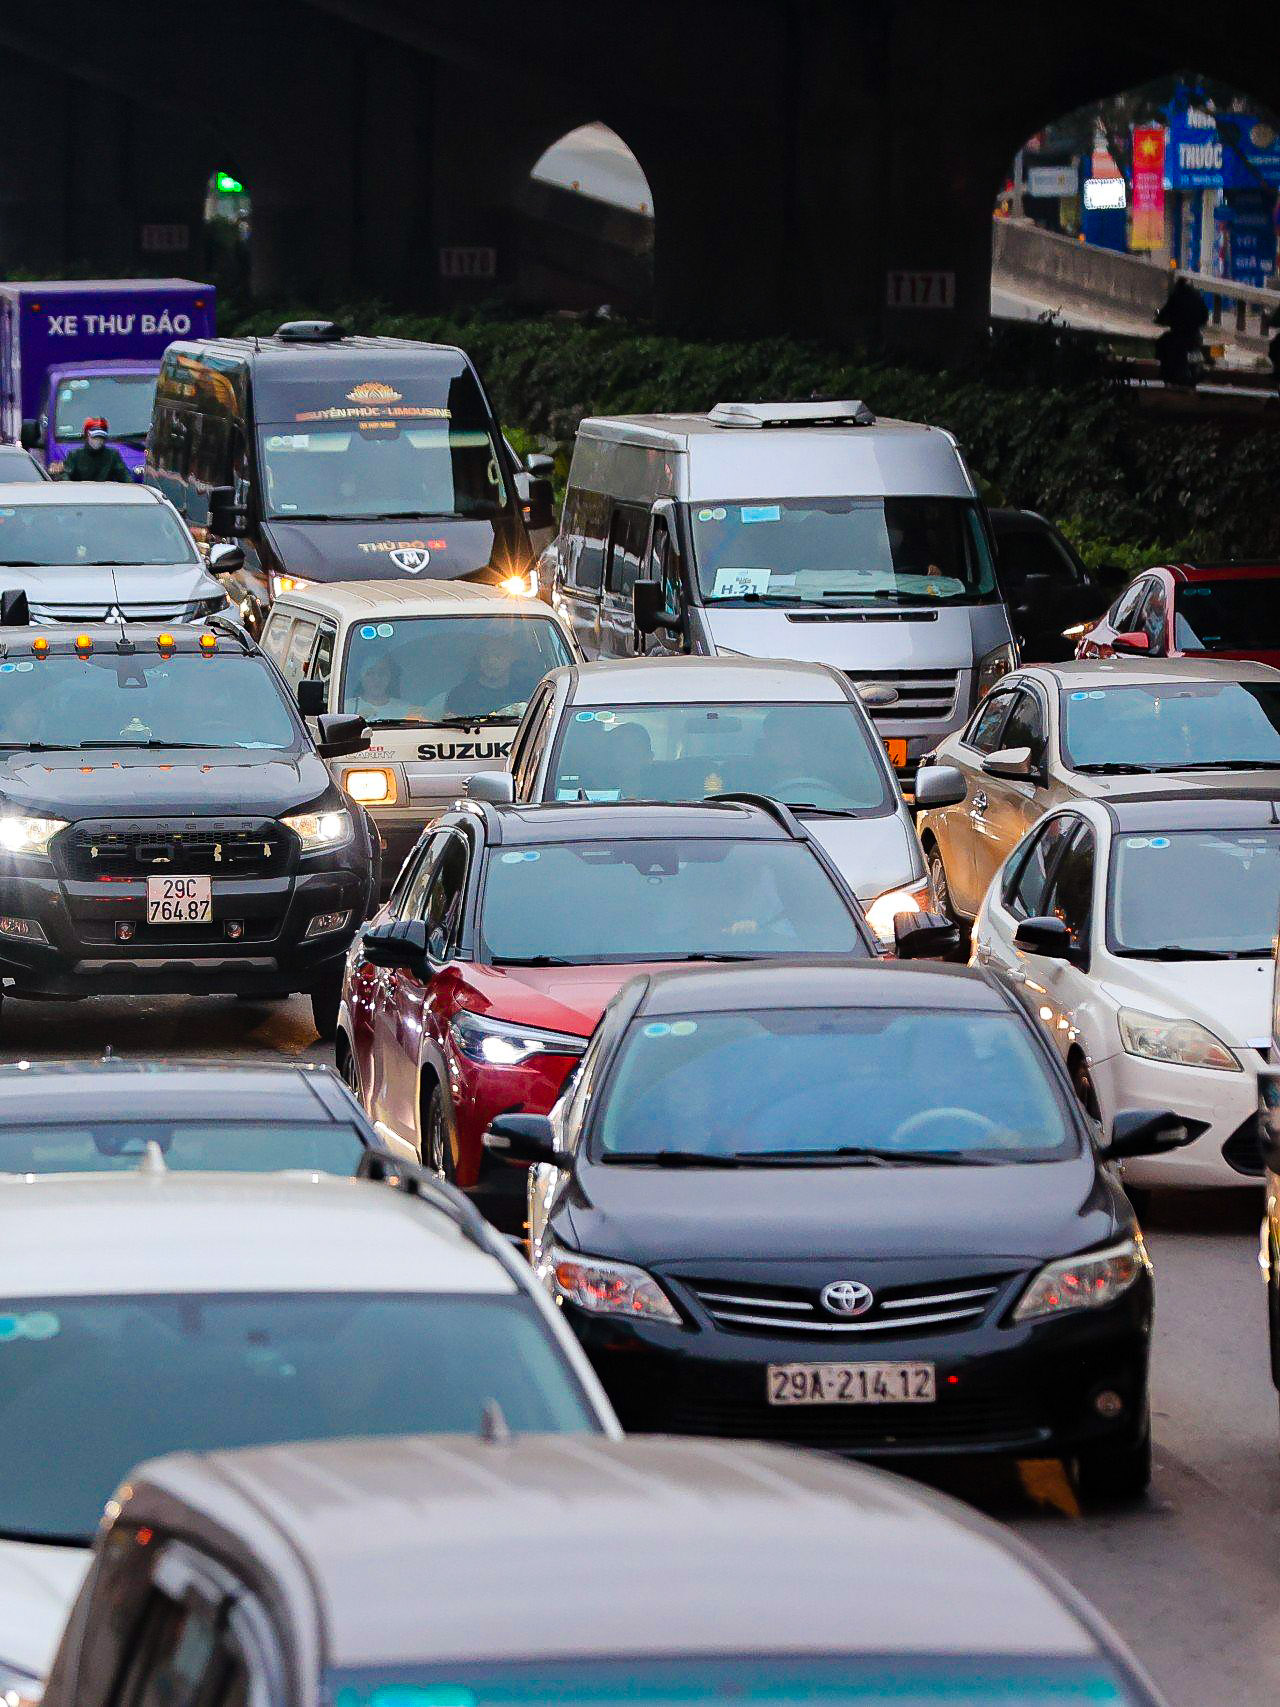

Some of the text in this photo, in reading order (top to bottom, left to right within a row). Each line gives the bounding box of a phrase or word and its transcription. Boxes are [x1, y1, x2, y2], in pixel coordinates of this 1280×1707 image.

[48, 308, 191, 336] XE THƯ BÁO
[388, 407, 452, 419] LIMOUSINE
[417, 742, 514, 760] SUZUK
[163, 879, 197, 899] 29C
[150, 900, 210, 921] 764.87
